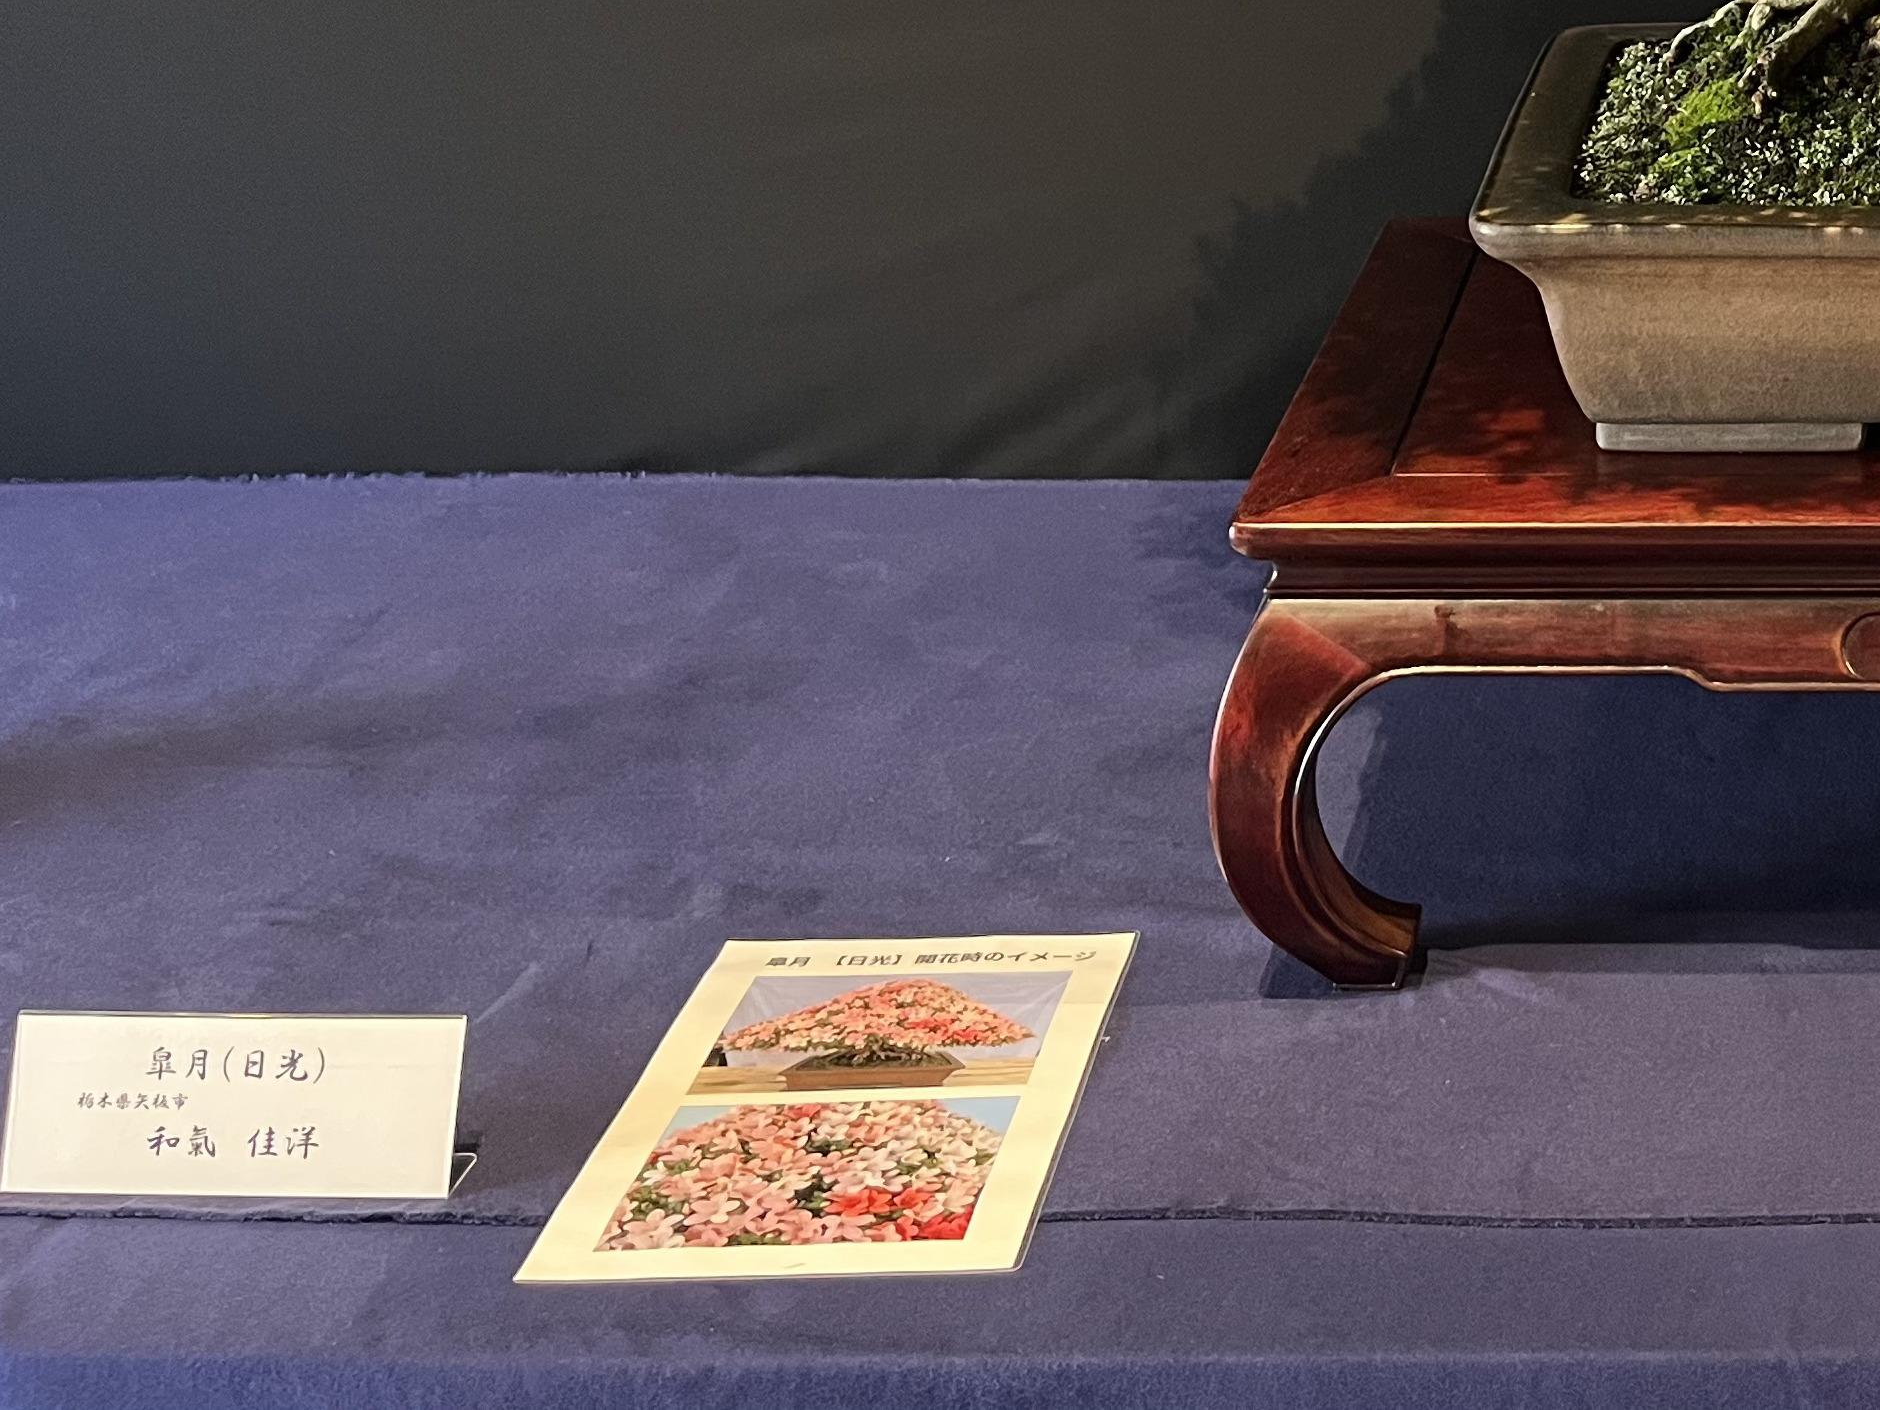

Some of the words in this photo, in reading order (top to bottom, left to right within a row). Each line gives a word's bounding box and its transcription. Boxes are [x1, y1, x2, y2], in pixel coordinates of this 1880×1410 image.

[78, 1092, 189, 1111] 栃木県矢板市
[147, 1125, 216, 1158] 和氣
[248, 1126, 319, 1159] 佳洋
